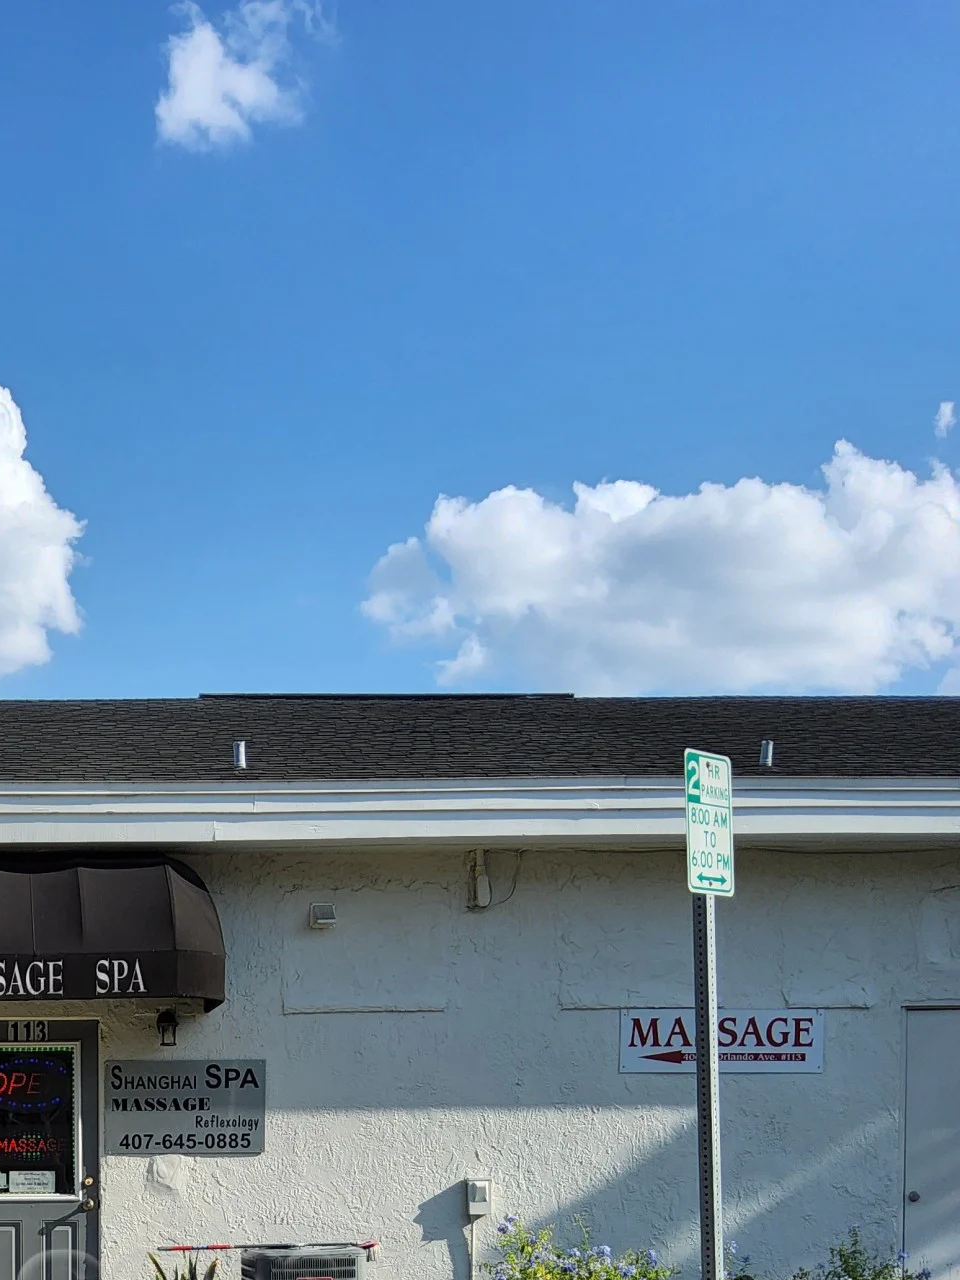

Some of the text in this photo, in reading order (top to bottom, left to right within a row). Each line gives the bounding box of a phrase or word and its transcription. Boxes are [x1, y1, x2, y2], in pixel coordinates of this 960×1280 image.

[688, 760, 721, 796] 2 HR
[701, 783, 729, 801] PARKING
[691, 807, 728, 829] 8:00 AM
[704, 830, 717, 848] TO
[692, 850, 730, 871] 6:00 PM
[95, 957, 148, 996] SPA
[11, 1021, 46, 1042] 113
[628, 1016, 814, 1048] MASAGE
[757, 1053, 777, 1061] Ave.
[781, 1053, 802, 1061] #113
[205, 1063, 260, 1089] SPA
[111, 1097, 211, 1112] MASSAGE
[195, 1115, 260, 1131] Reflexology
[119, 1133, 251, 1150] 407-645-0885
